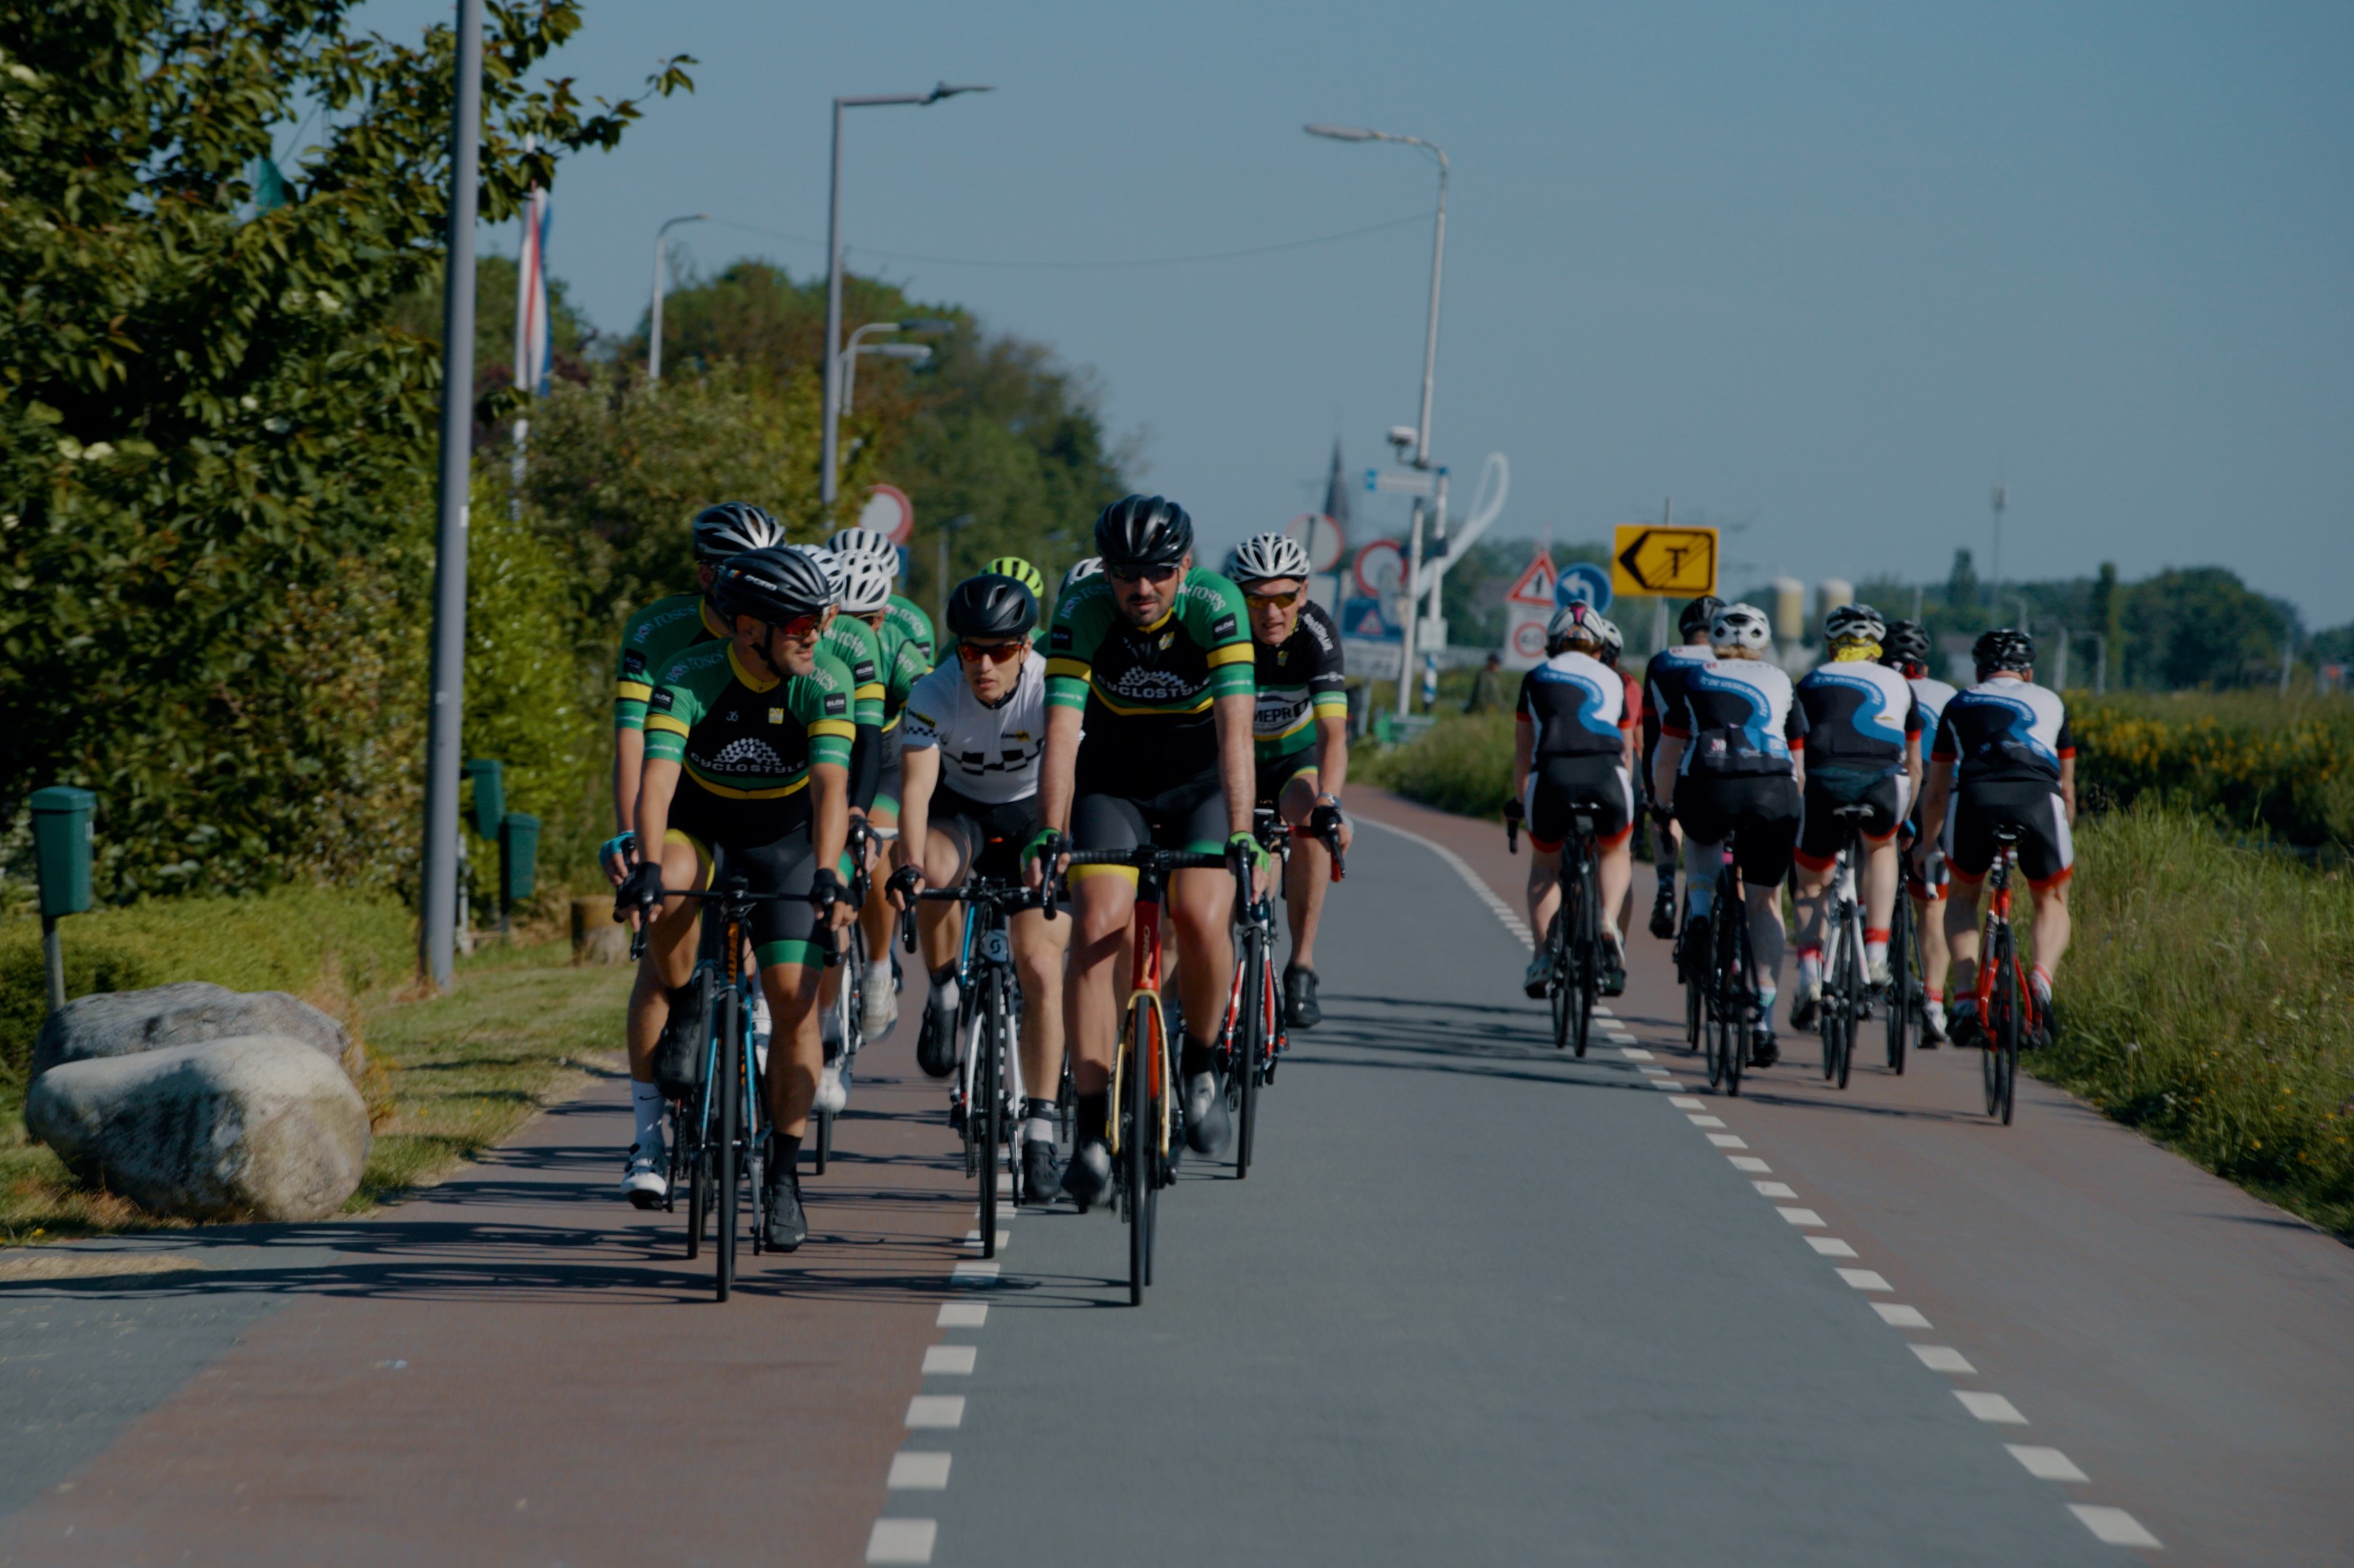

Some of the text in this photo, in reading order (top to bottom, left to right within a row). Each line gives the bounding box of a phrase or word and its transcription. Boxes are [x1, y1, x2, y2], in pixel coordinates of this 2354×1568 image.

[1666, 547, 1688, 578] T
[652, 604, 697, 628] roses
[1214, 619, 1236, 634] BLOK
[665, 650, 725, 684] BOS roses
[808, 668, 838, 692] oses
[654, 692, 672, 703] BLOK
[826, 698, 845, 708] BLOK
[690, 751, 805, 774] CYCLOSTYLE
